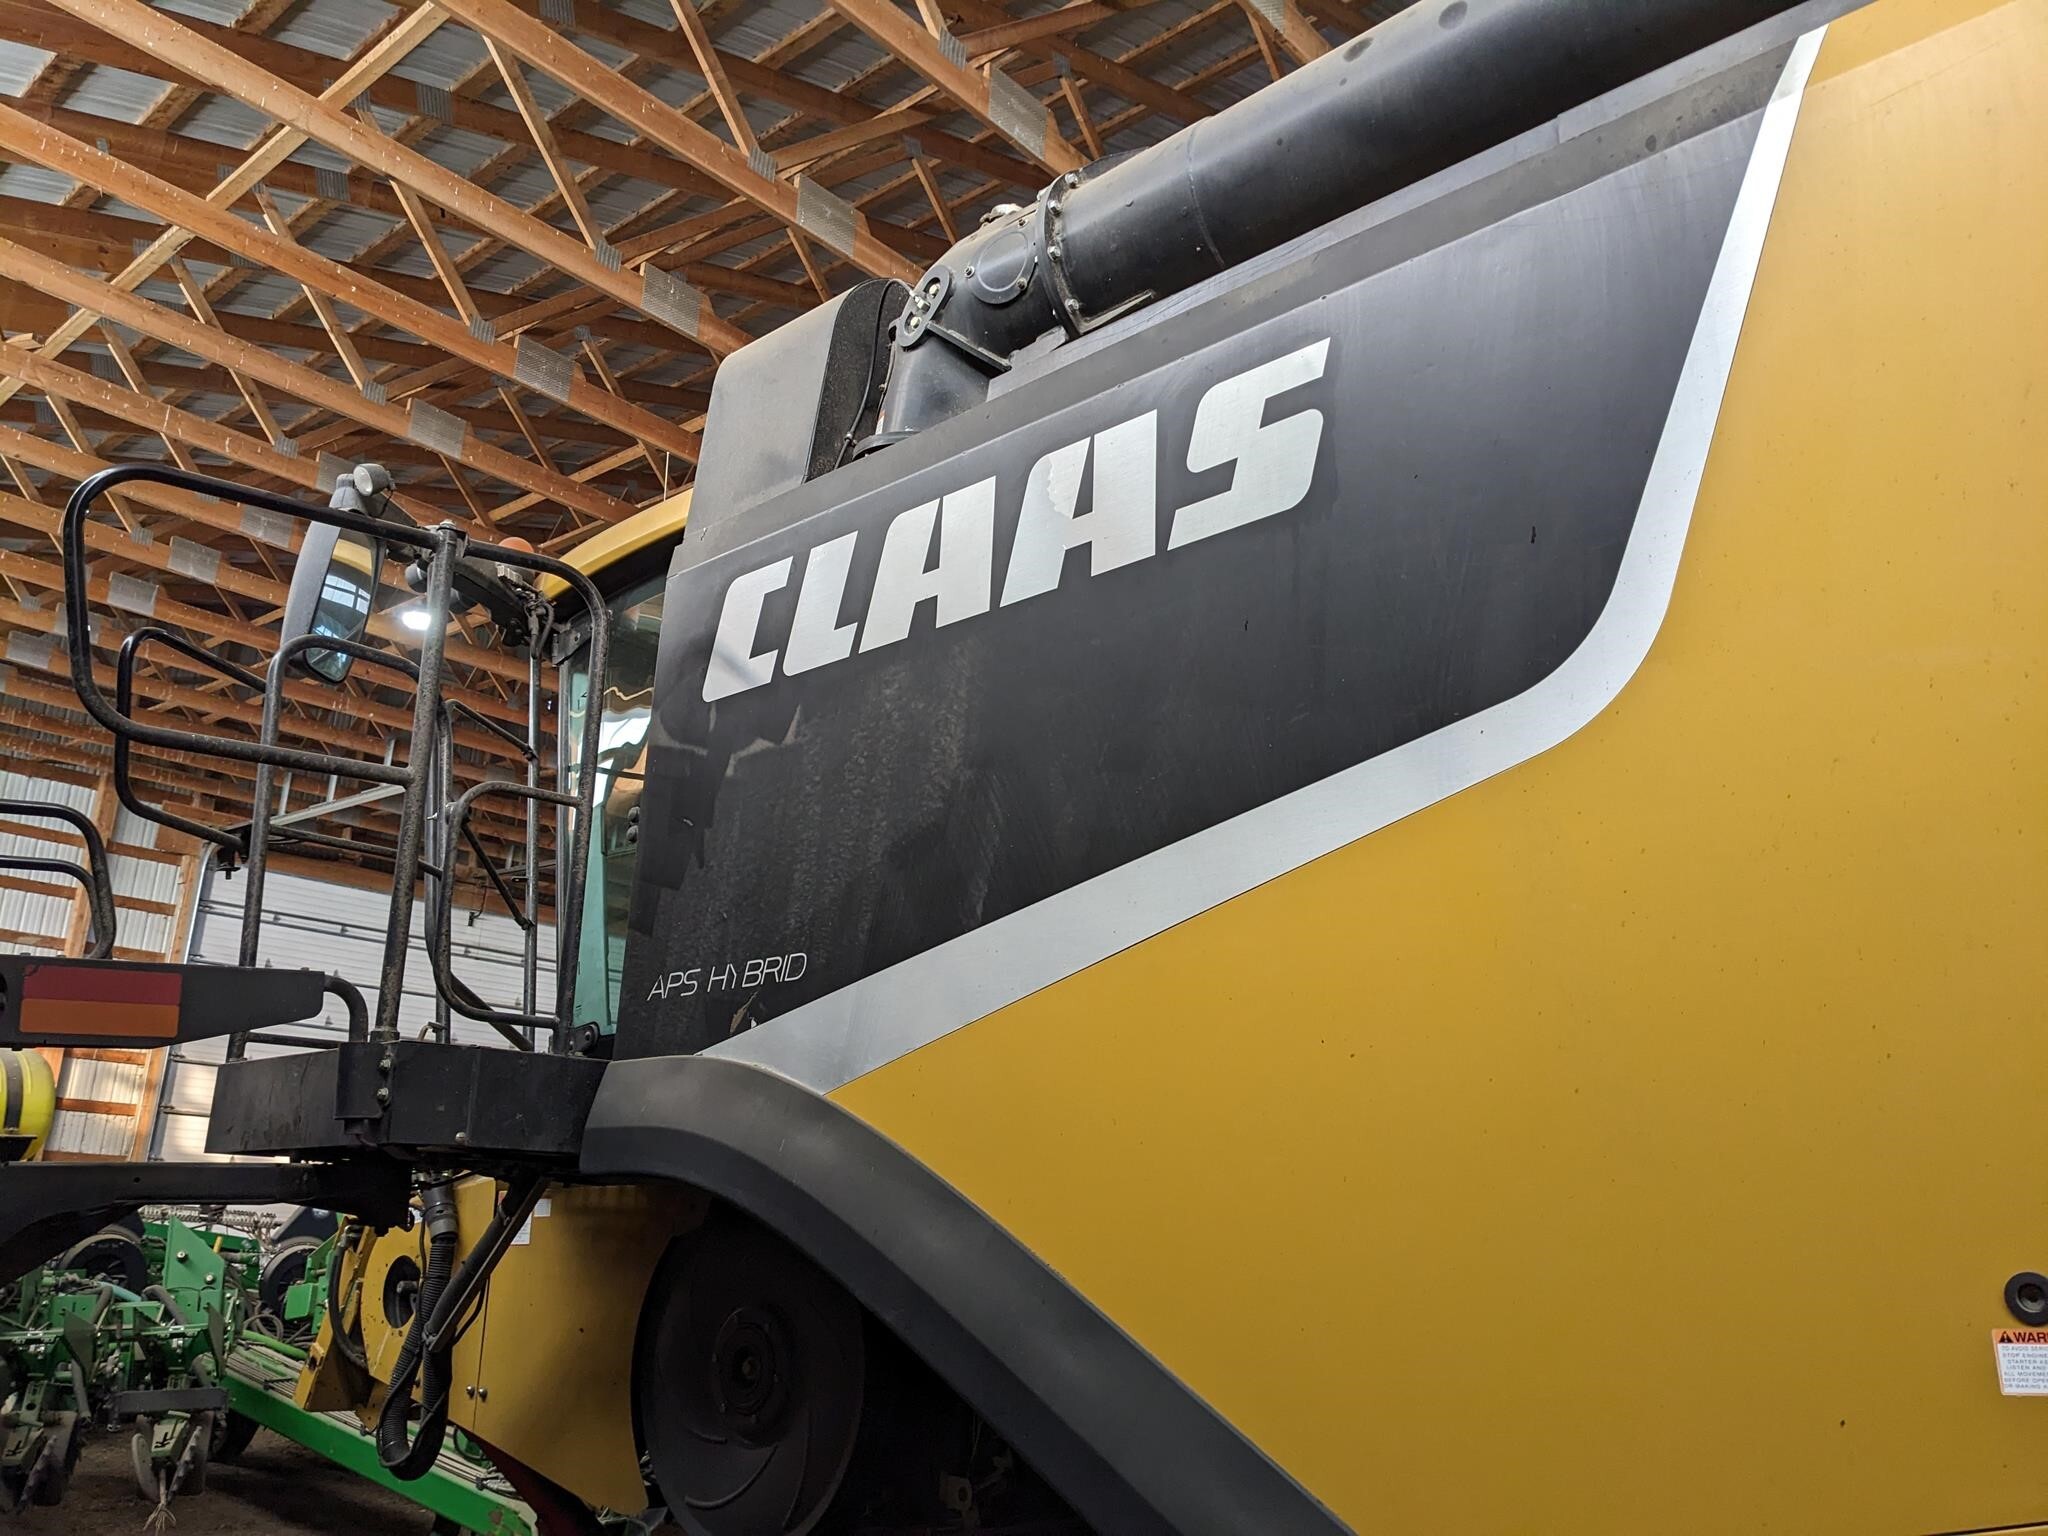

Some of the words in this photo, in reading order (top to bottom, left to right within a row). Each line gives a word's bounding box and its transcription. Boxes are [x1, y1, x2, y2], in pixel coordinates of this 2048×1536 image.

[702, 337, 1331, 703] CLAAS
[646, 968, 702, 1001] APS
[707, 952, 808, 993] HYBRID
[2013, 1331, 2048, 1343] WAR
